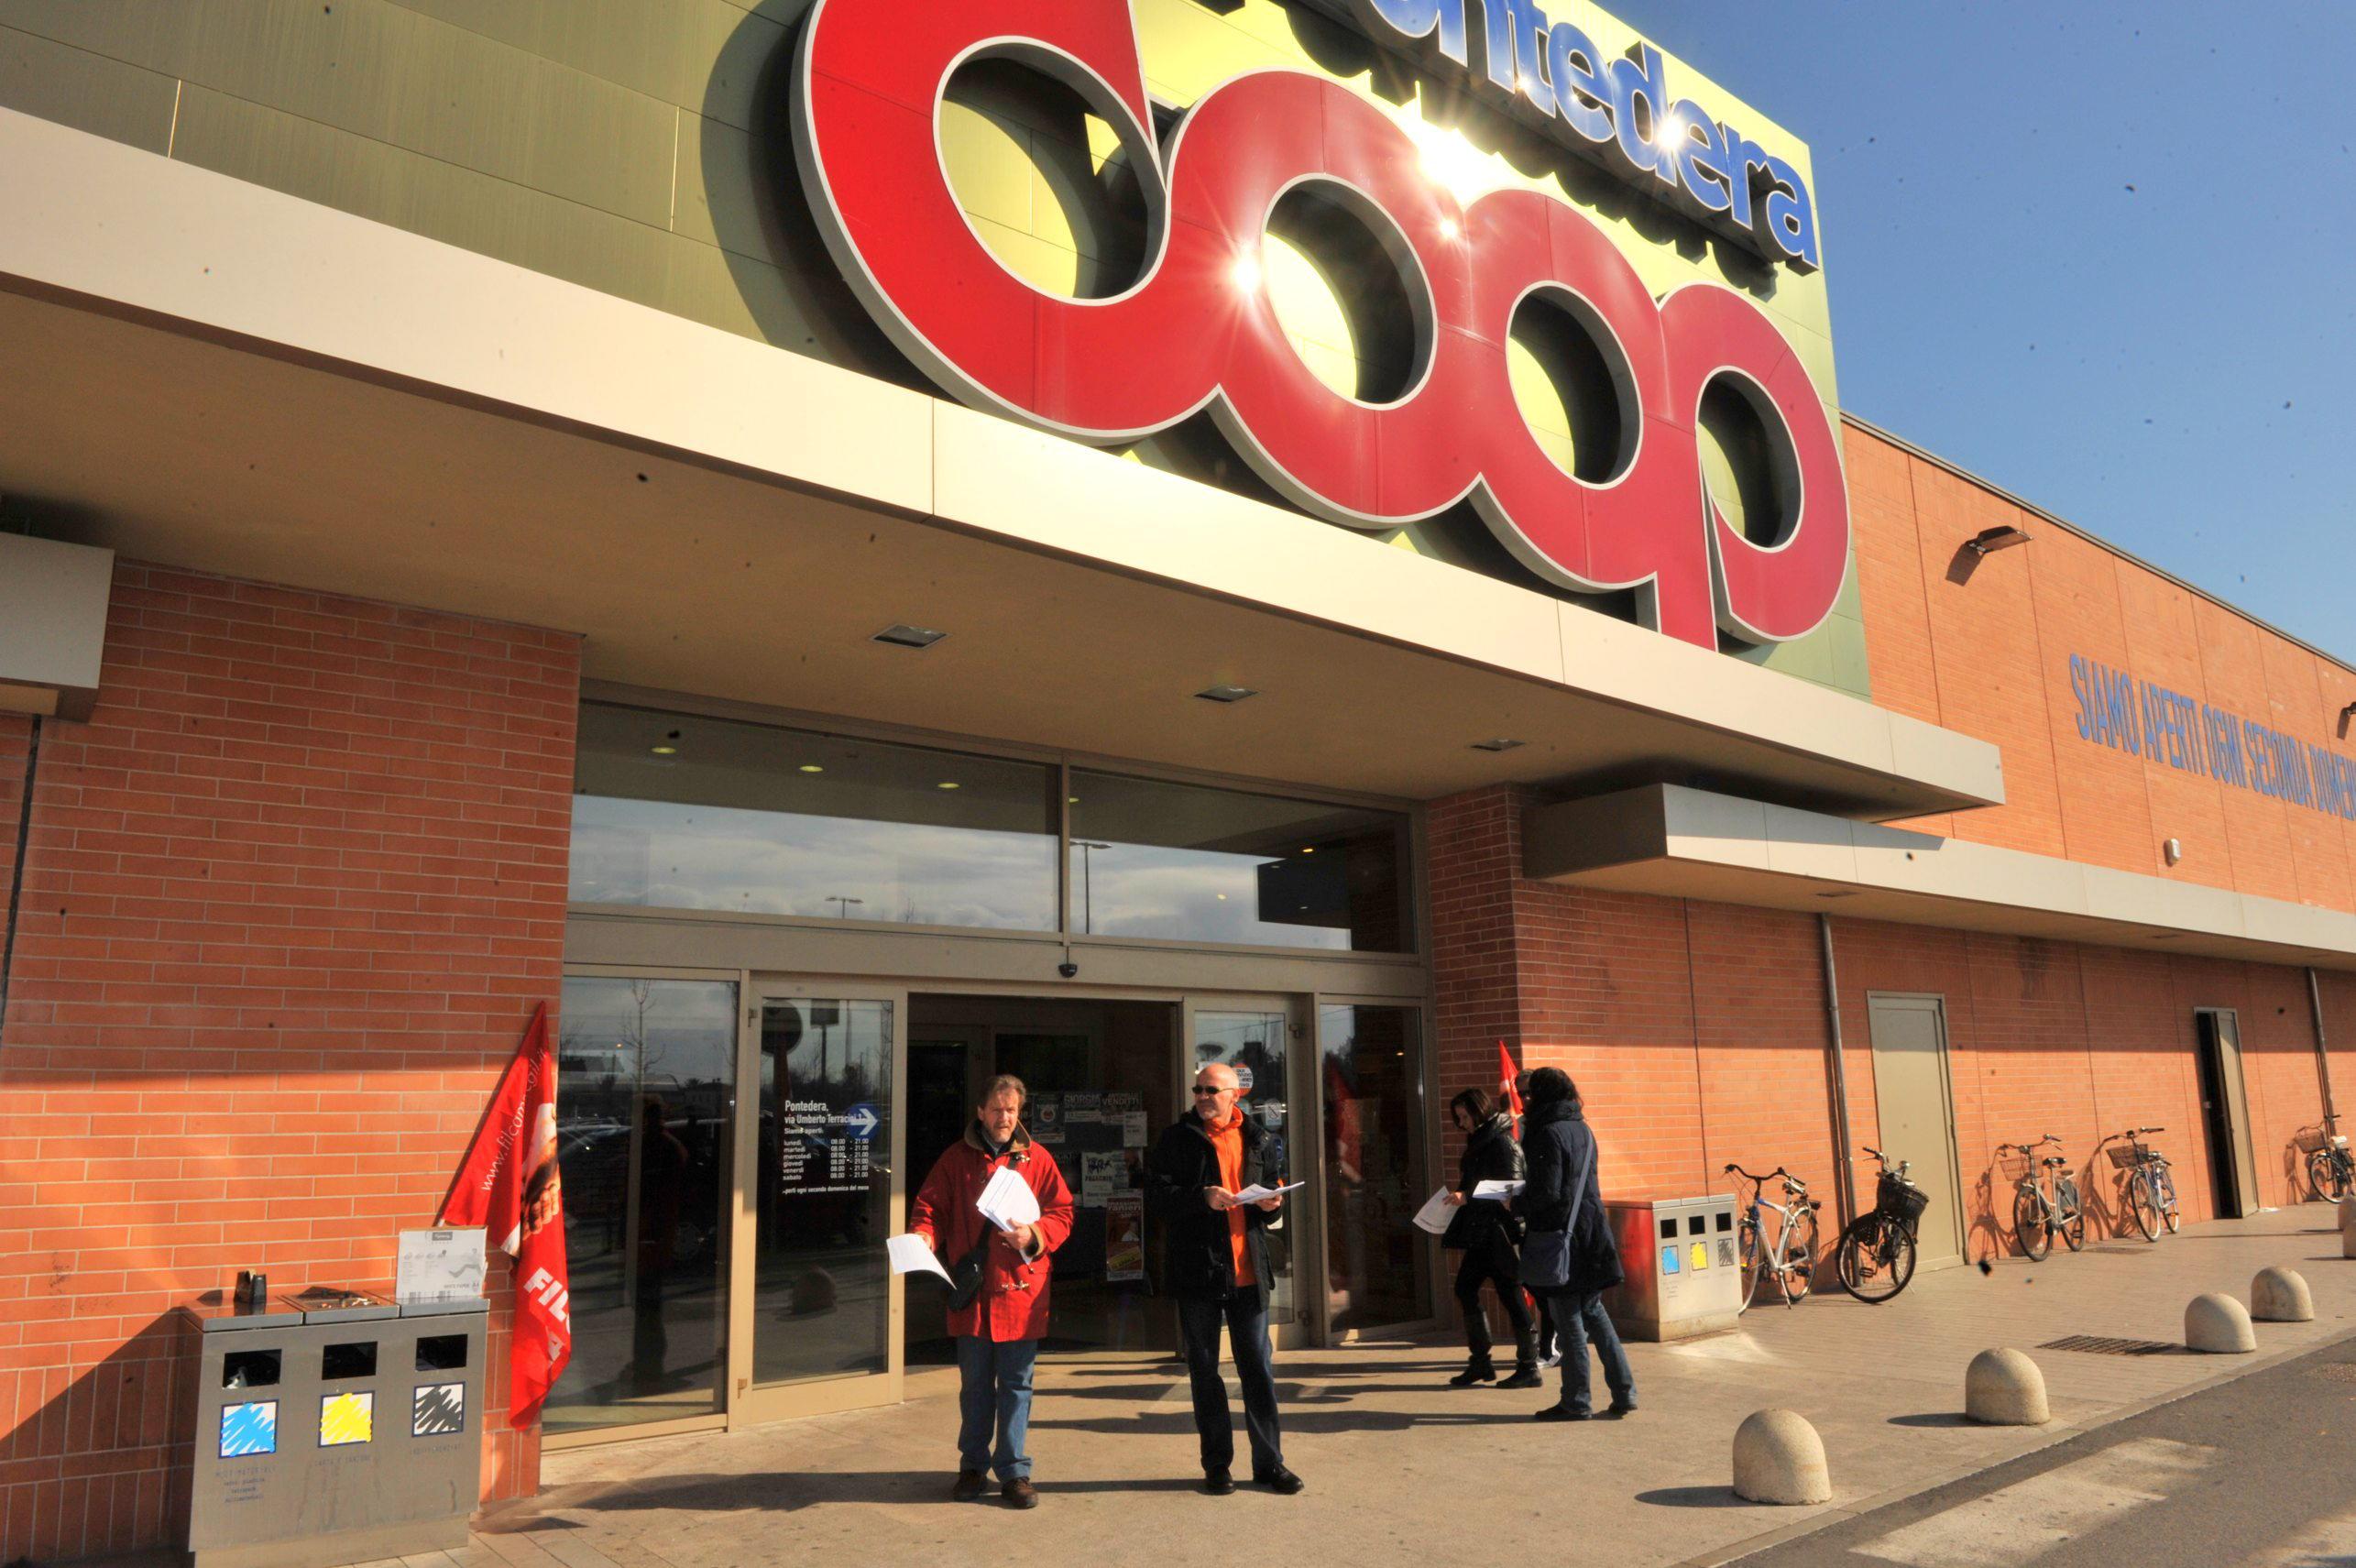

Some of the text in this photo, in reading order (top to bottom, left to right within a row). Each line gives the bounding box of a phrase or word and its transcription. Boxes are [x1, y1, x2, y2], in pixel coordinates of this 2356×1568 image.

[794, 0, 1849, 652] coop
[2069, 652, 2141, 756] SIAMO
[2140, 679, 2207, 776] APERTI
[2201, 703, 2247, 789] OGNI
[2244, 718, 2315, 809] SECONDA
[784, 1114, 795, 1124] via
[796, 1114, 827, 1124] Umberto
[523, 1266, 570, 1335] FIL
